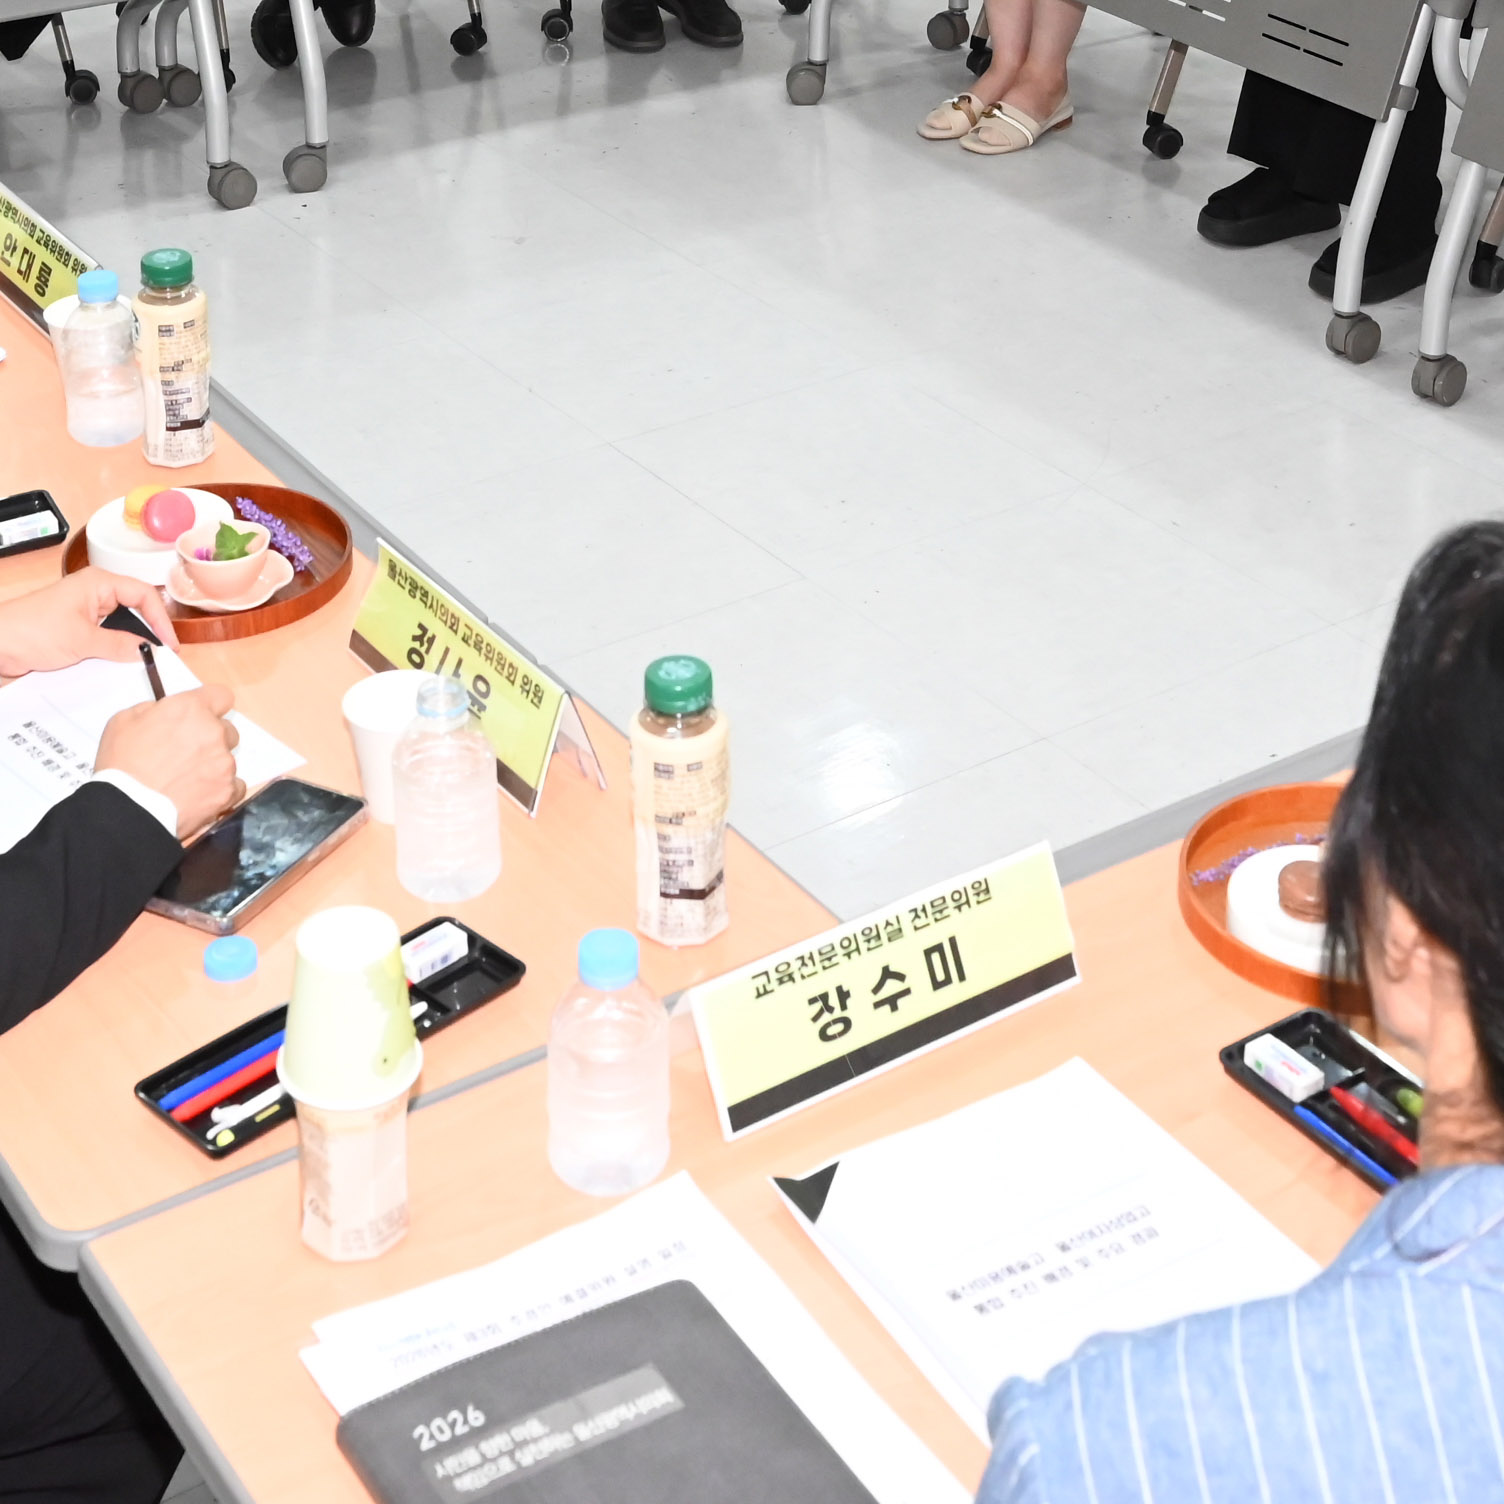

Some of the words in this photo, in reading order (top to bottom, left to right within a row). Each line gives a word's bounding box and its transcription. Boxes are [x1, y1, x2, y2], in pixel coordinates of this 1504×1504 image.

[37, 227, 73, 269] 교육위원회
[387, 558, 460, 636] 울산광역시의회
[460, 623, 519, 688] 교육위원회
[519, 673, 545, 710] 위원
[751, 914, 905, 1000] 교육전문위원실
[908, 877, 993, 932] 전문위원
[411, 1401, 487, 1452] 2026
